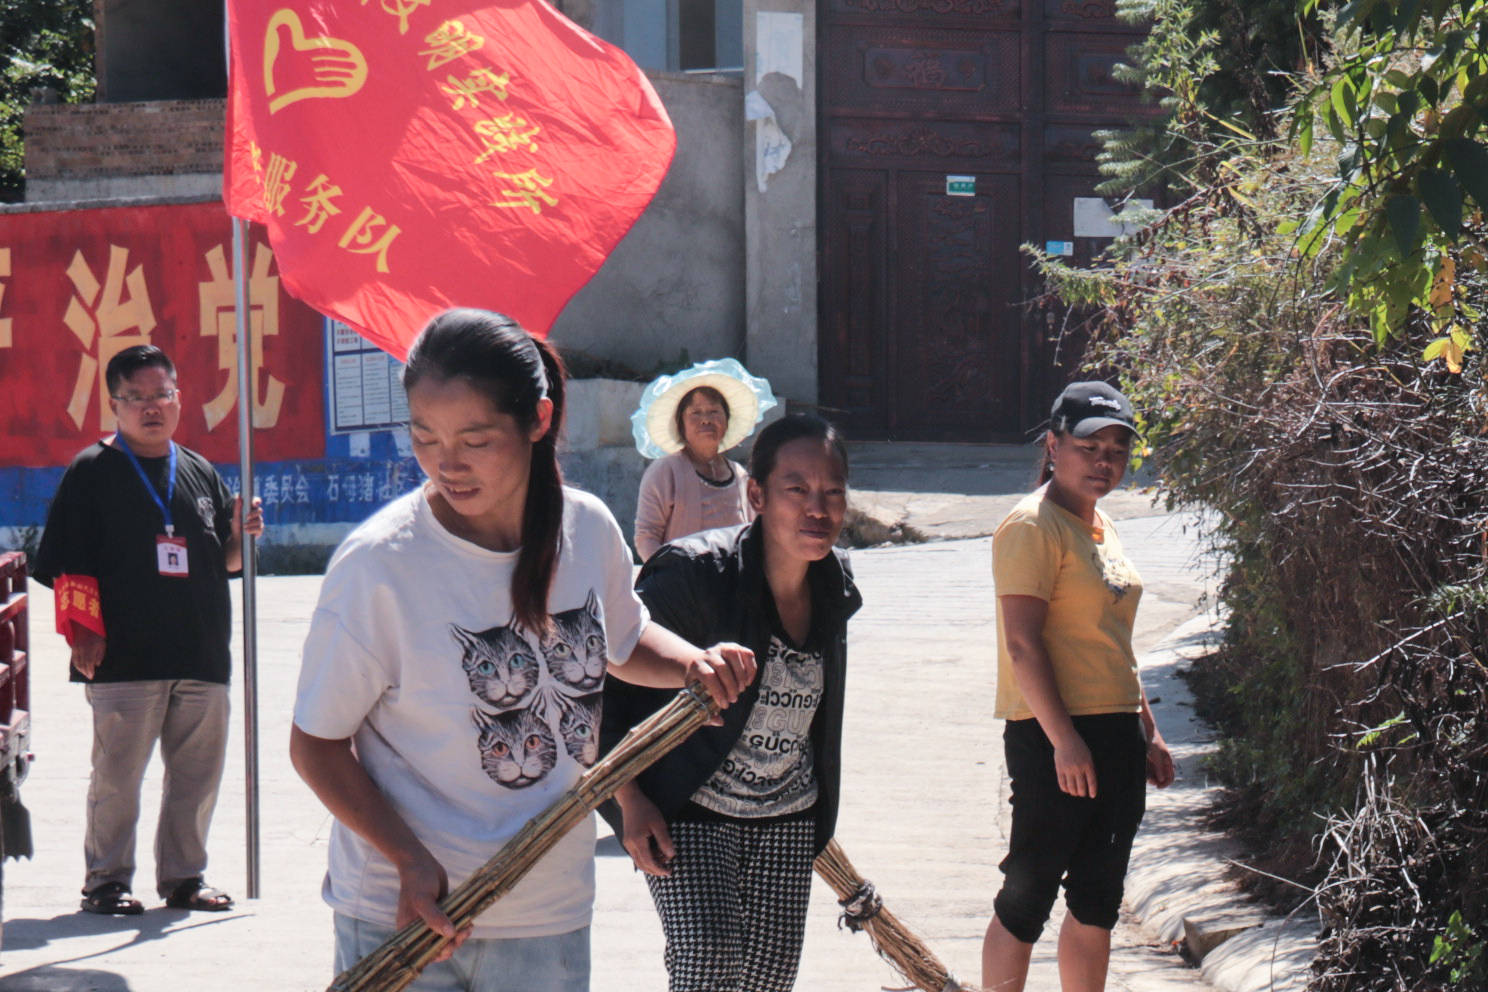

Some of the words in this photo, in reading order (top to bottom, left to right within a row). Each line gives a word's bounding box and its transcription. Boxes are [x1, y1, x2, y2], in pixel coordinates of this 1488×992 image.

[361, 0, 558, 214] 文明实践所
[250, 141, 402, 273] 服务队
[0, 241, 286, 432] 治党
